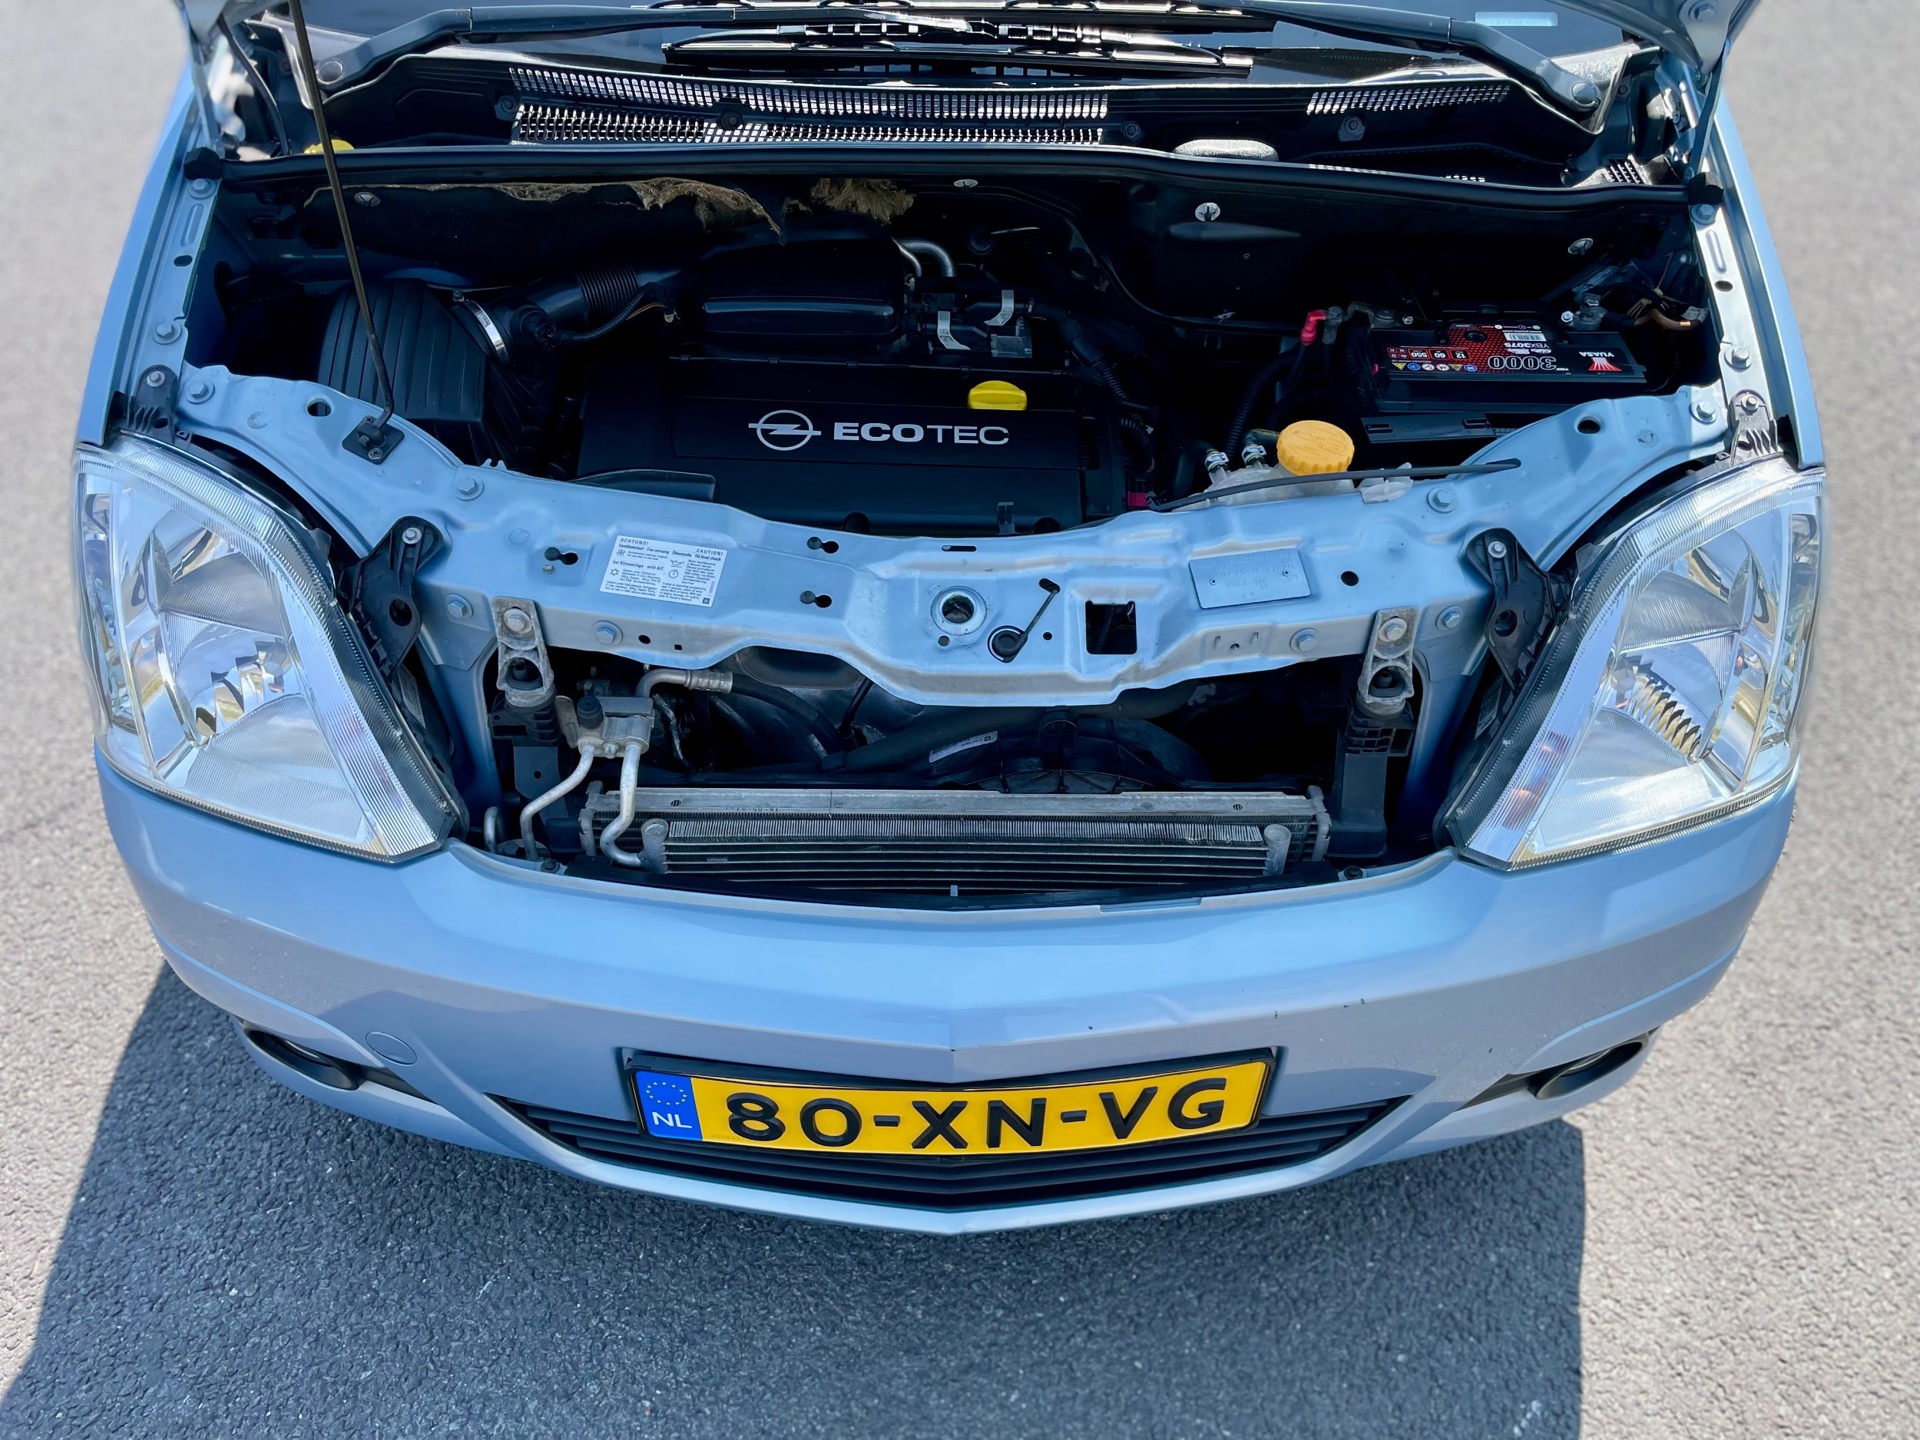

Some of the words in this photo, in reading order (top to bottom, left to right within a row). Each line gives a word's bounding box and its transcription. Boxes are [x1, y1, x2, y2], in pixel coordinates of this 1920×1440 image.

[1488, 355, 1557, 370] 3000
[833, 422, 1010, 445] ECOTEC
[696, 548, 724, 556] CAUTION!
[651, 1111, 693, 1129] NL
[726, 1077, 1227, 1149] 80-XN-VG
